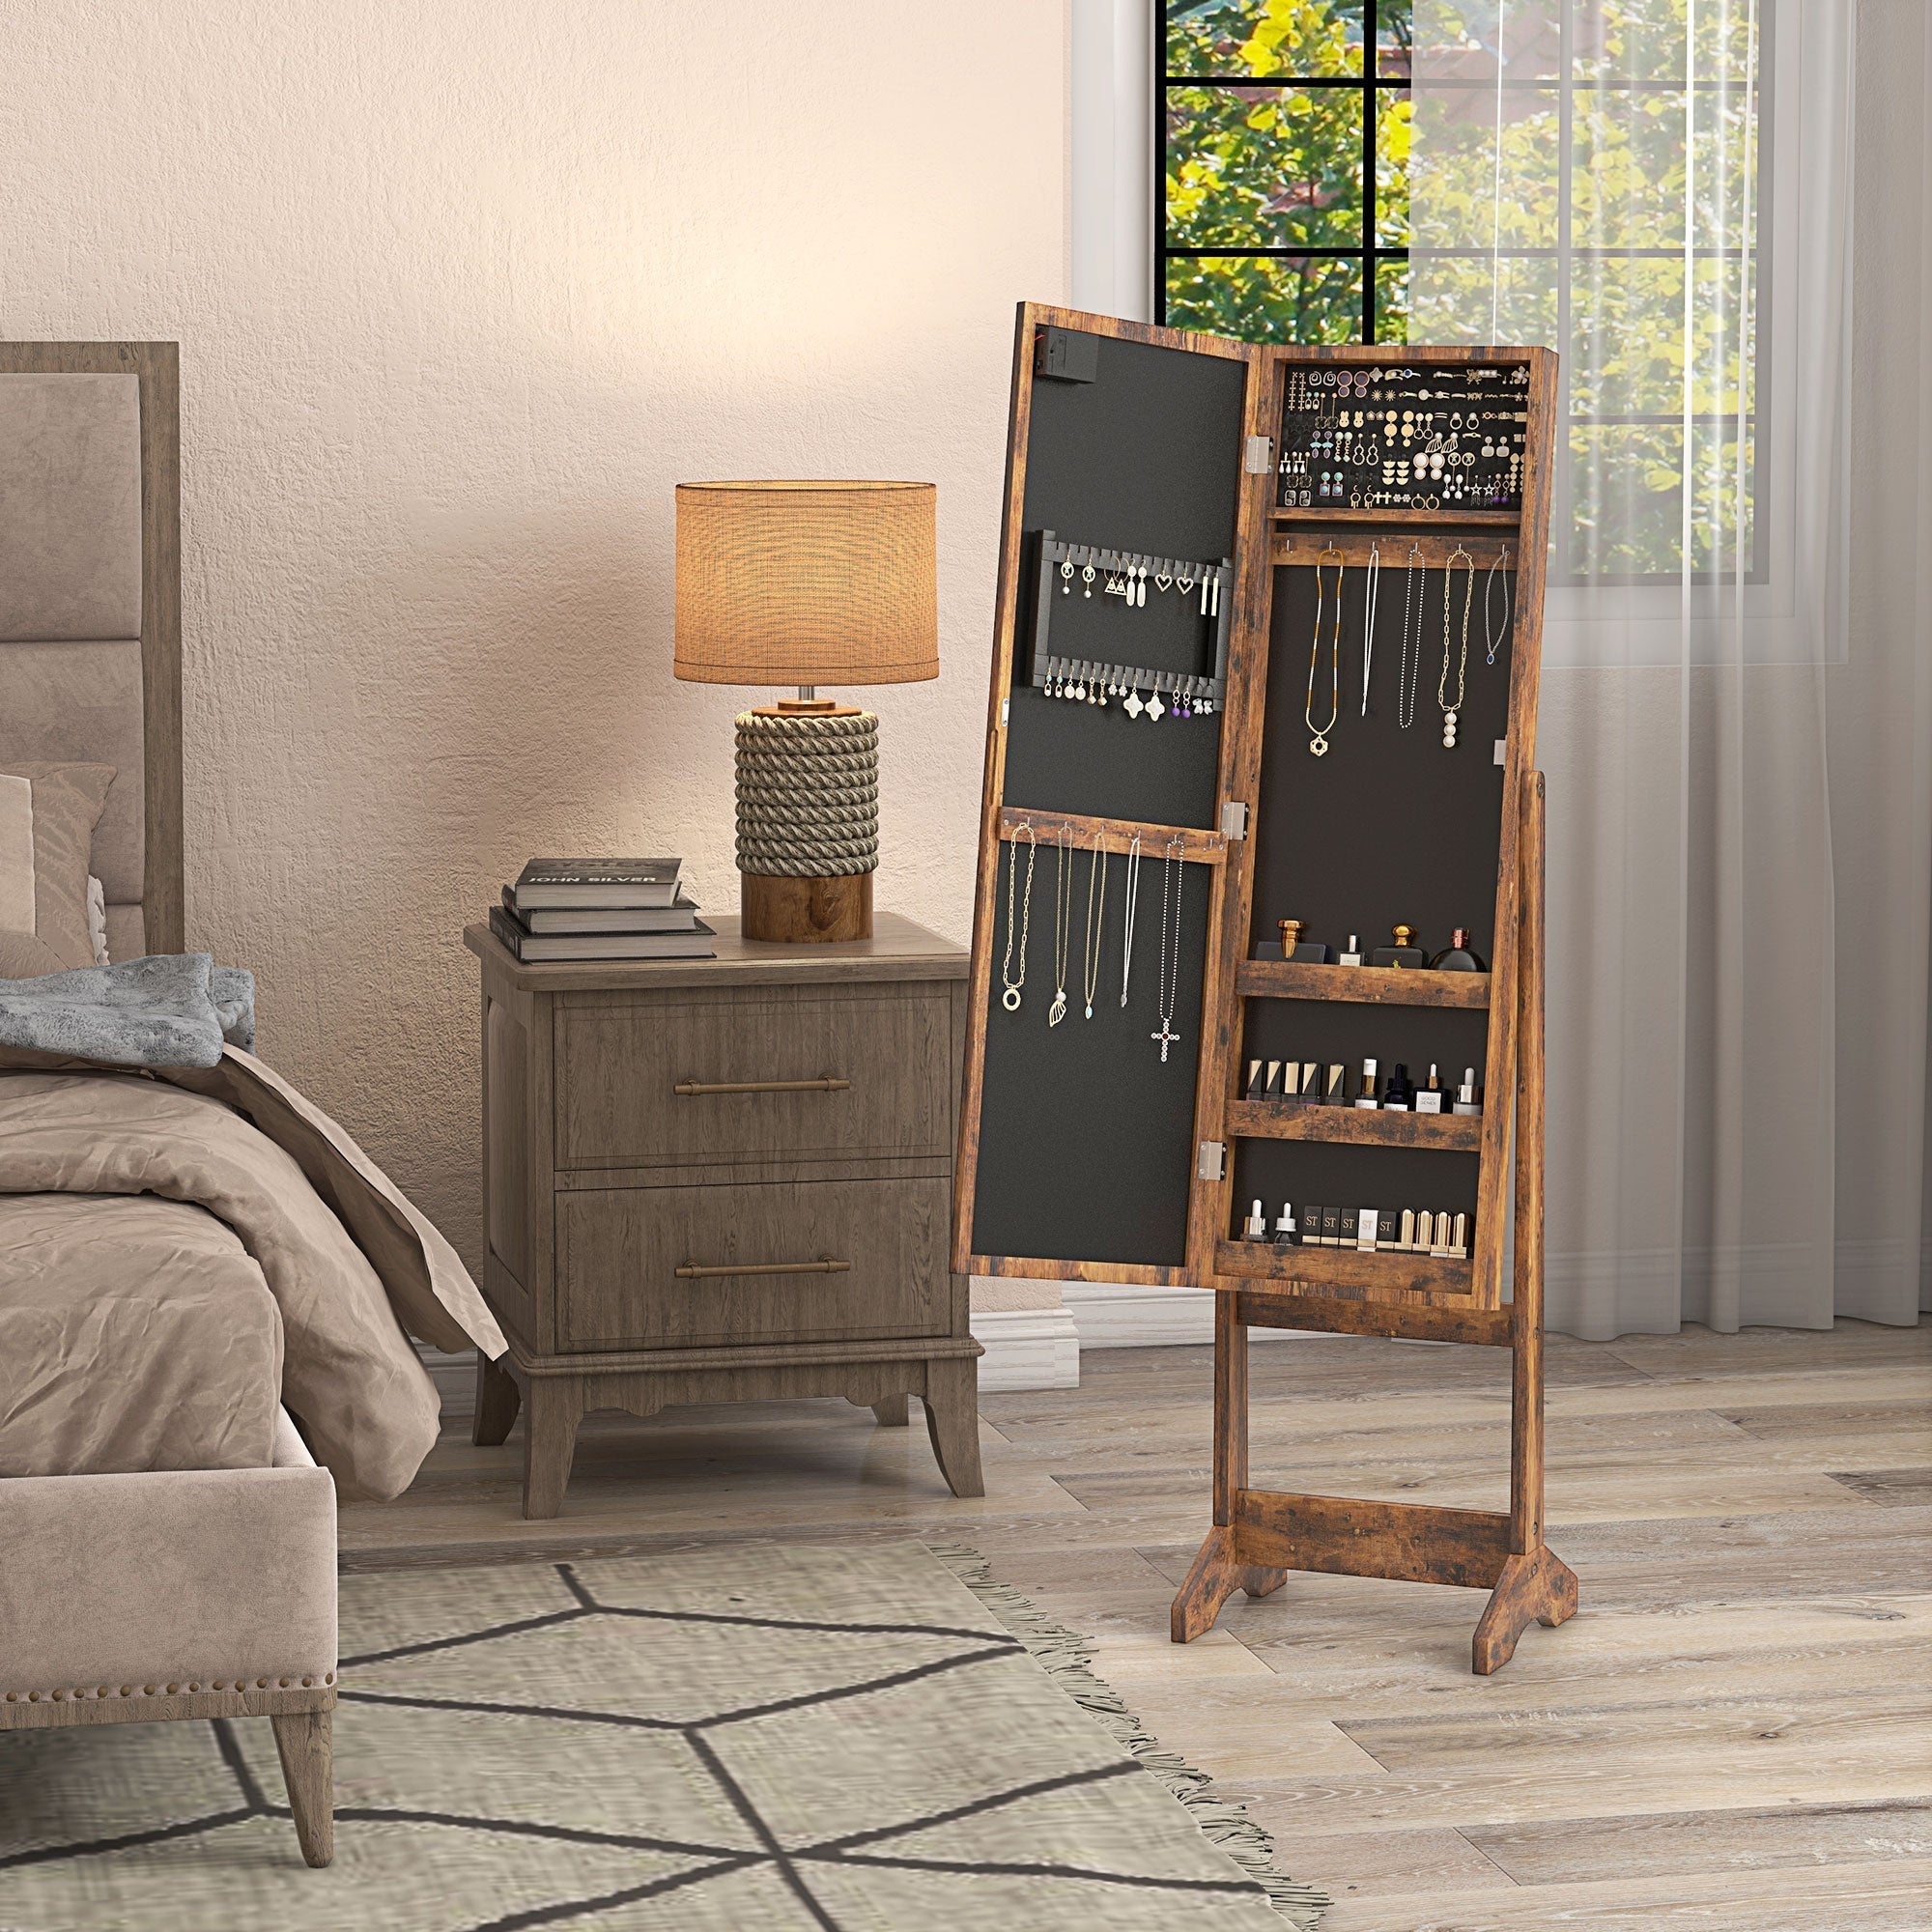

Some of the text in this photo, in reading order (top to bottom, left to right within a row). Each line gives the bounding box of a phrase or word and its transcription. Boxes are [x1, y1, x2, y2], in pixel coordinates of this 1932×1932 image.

[1306, 1215, 1318, 1226] ST
[1324, 1217, 1337, 1228] ST
[1343, 1218, 1354, 1229] ST
[1362, 1219, 1374, 1231] ST
[1379, 1221, 1392, 1232] ST
